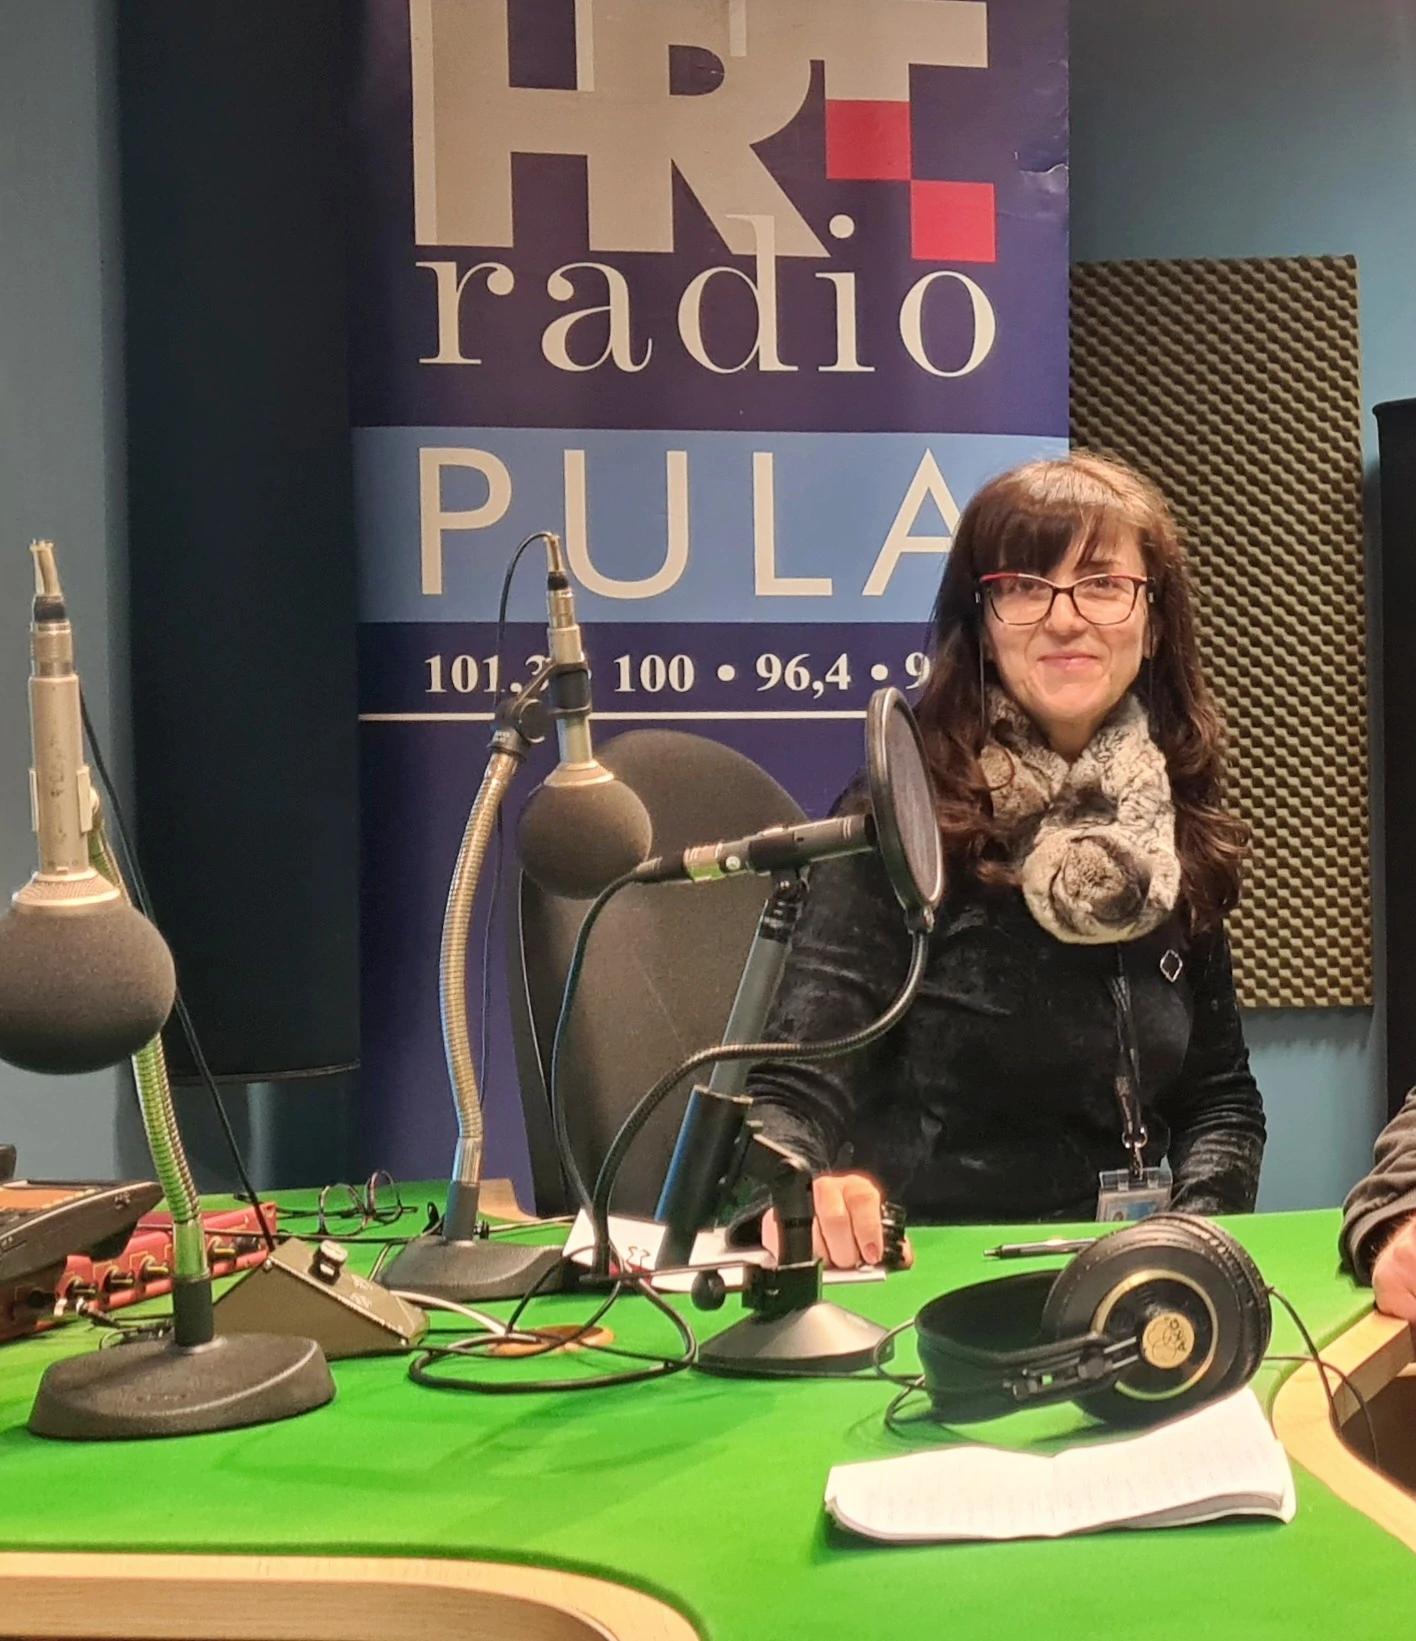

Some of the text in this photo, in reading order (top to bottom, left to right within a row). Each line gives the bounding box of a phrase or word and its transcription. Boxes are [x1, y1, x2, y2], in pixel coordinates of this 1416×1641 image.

[410, 0, 997, 262] HRT
[414, 214, 996, 377] radio
[418, 447, 960, 600] PULA
[614, 654, 695, 693] 100
[756, 653, 851, 699] 96,4
